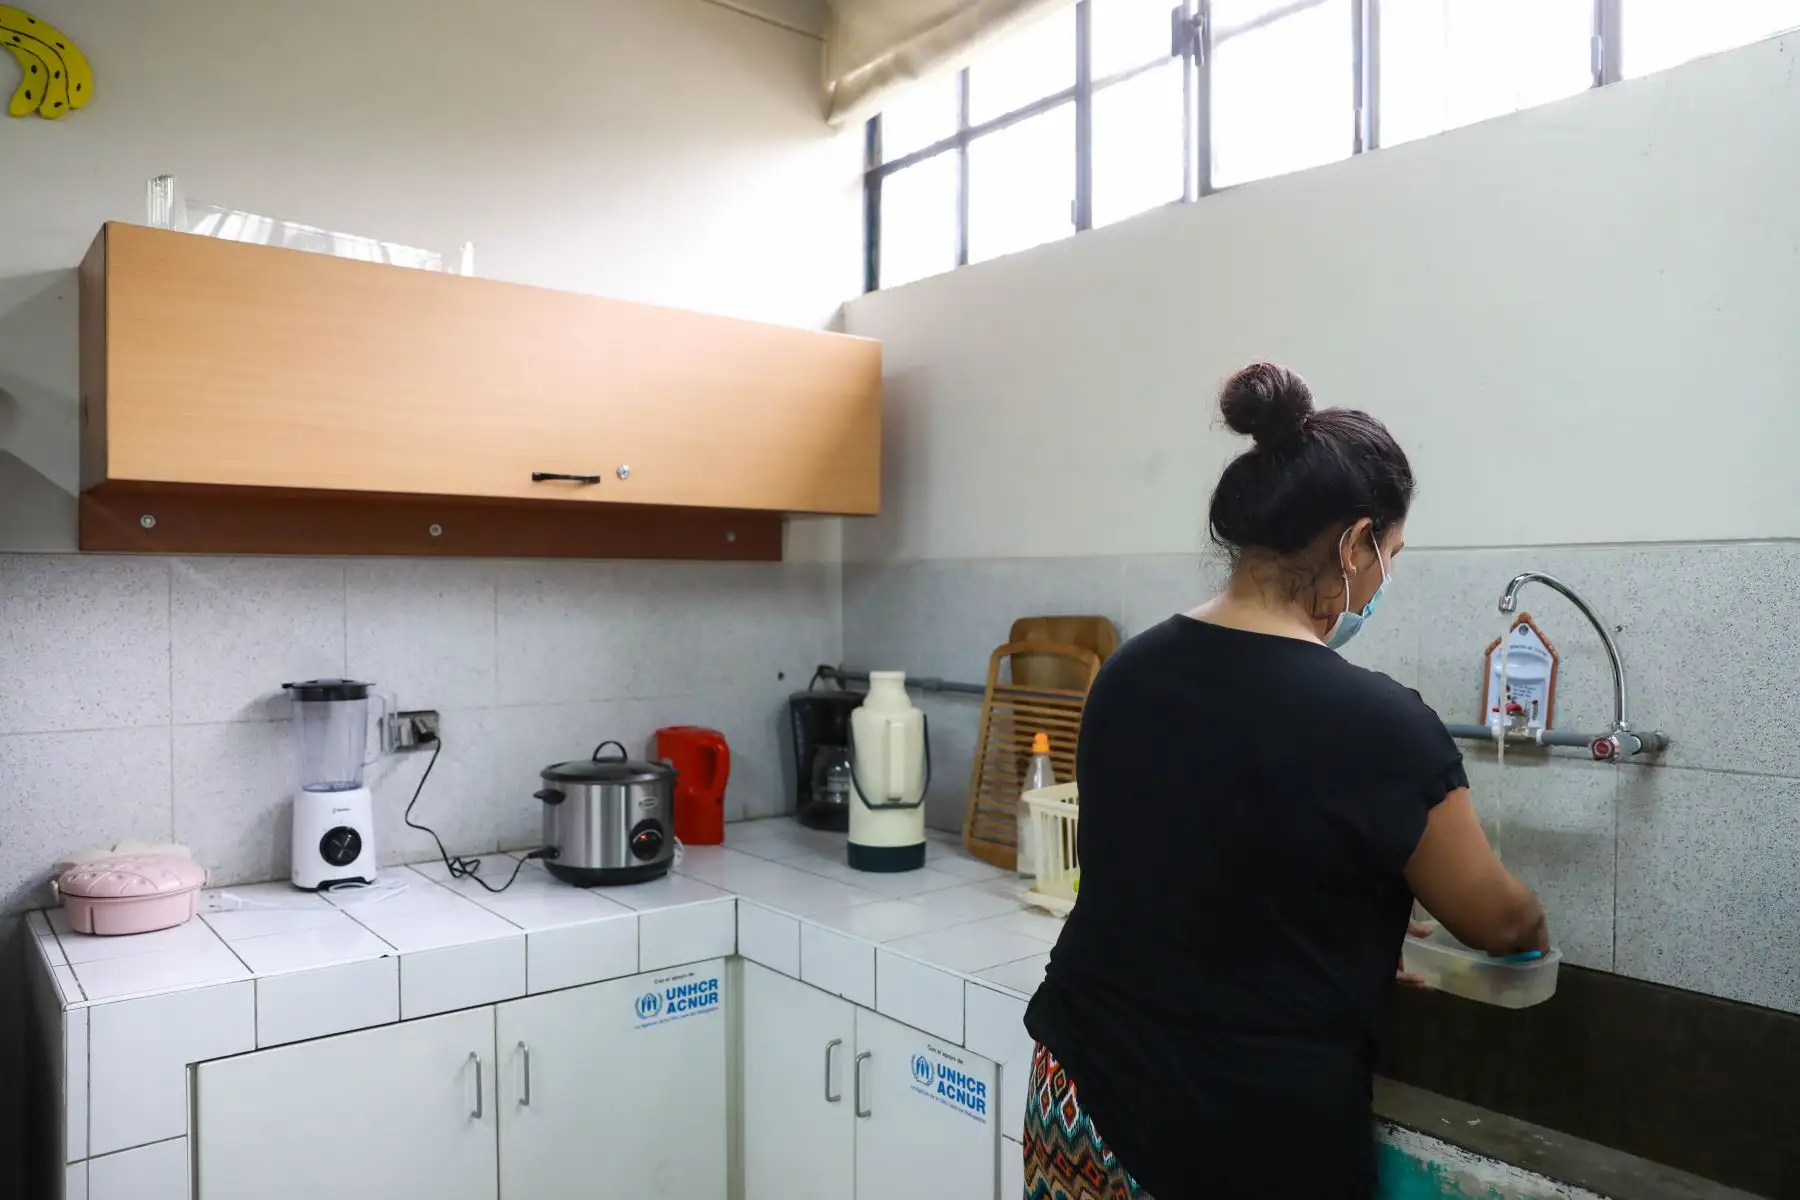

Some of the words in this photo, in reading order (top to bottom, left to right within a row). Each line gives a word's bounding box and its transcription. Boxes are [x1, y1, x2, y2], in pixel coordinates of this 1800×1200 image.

[666, 978, 718, 1000] UNHCR
[666, 992, 718, 1015] ACNUR
[937, 1063, 986, 1098] UNHCR
[937, 1080, 986, 1115] ACNUR
